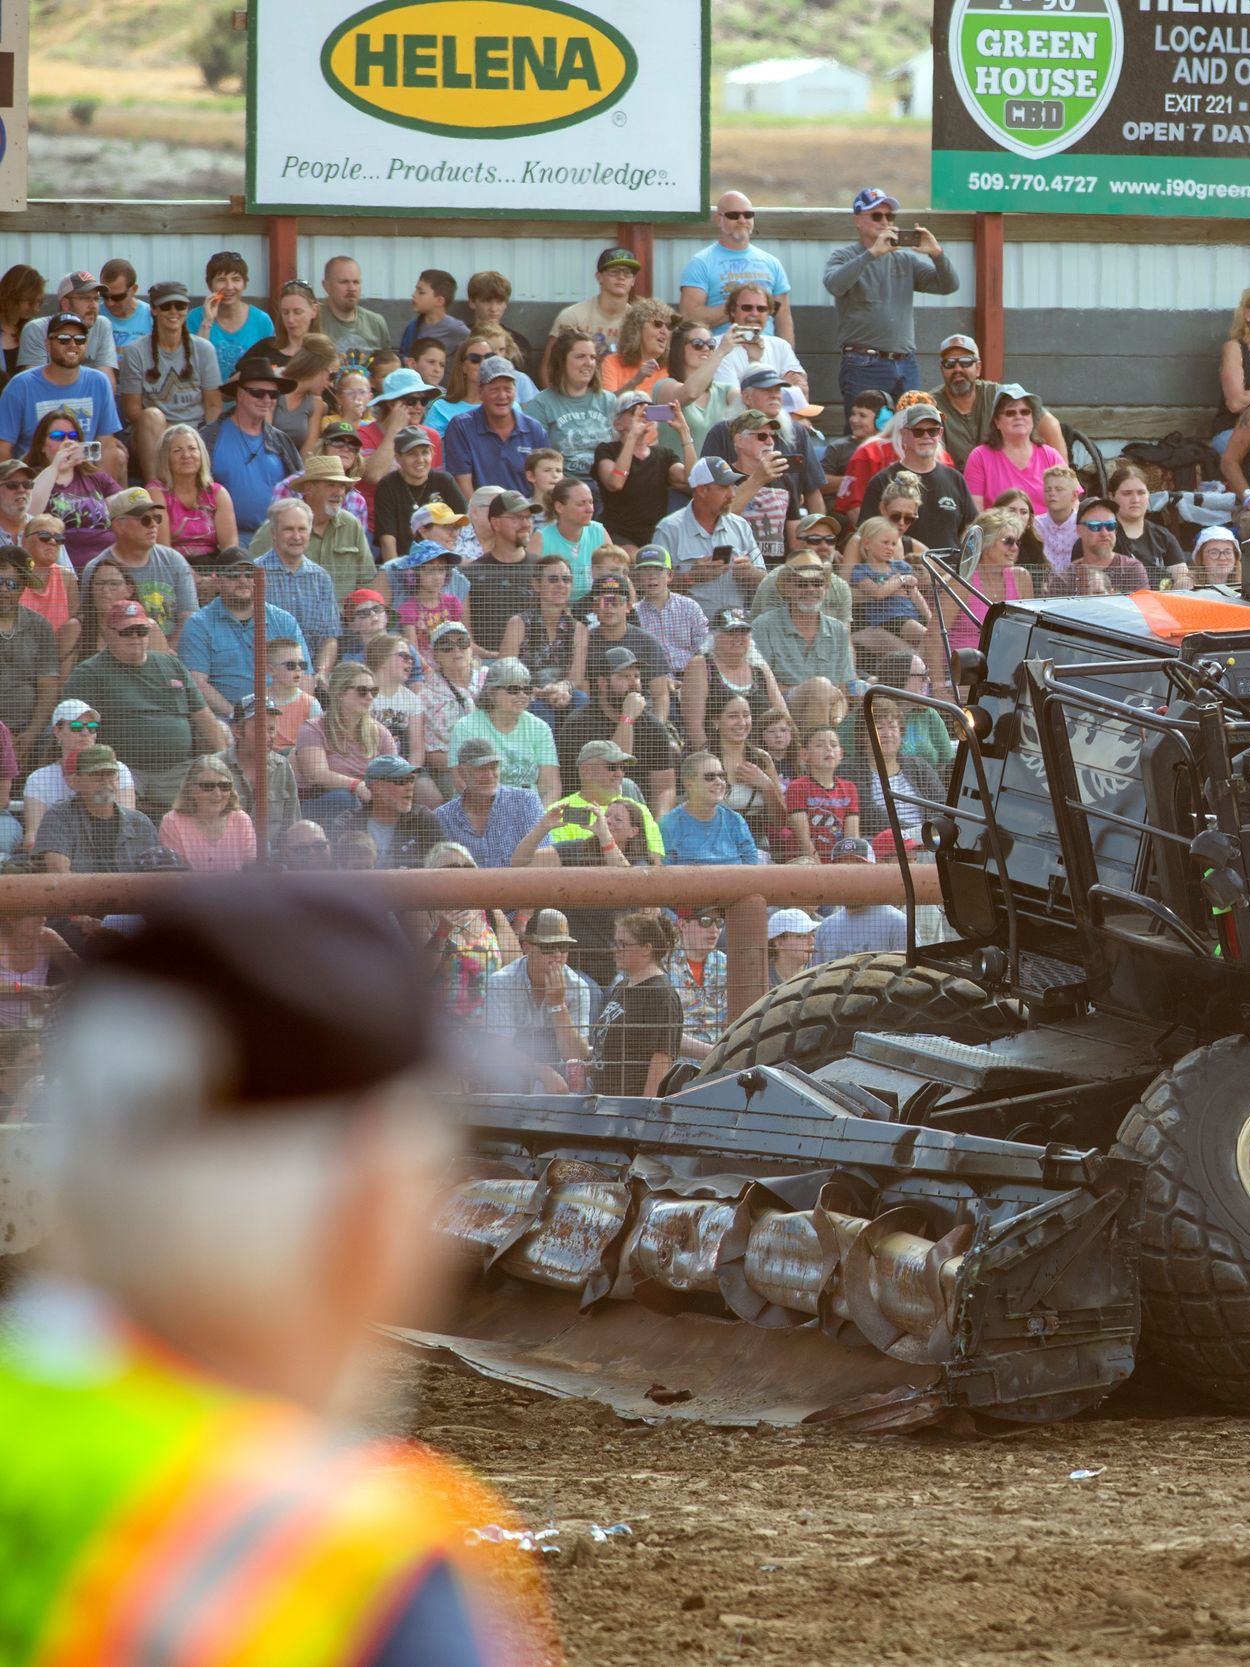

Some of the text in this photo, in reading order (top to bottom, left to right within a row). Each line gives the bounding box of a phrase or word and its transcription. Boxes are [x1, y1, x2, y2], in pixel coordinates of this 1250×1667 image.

[976, 29, 1097, 59] GREEN
[355, 33, 602, 91] HELENA
[1172, 57, 1228, 84] AND
[976, 66, 1097, 98] HOUSE
[1165, 94, 1202, 113] EXIT
[1205, 95, 1233, 114] 221
[1122, 121, 1185, 142] OPEN
[1192, 124, 1206, 142] 7
[281, 156, 380, 185] People...
[386, 158, 516, 186] Products...
[968, 172, 1098, 193] 509.770.4727
